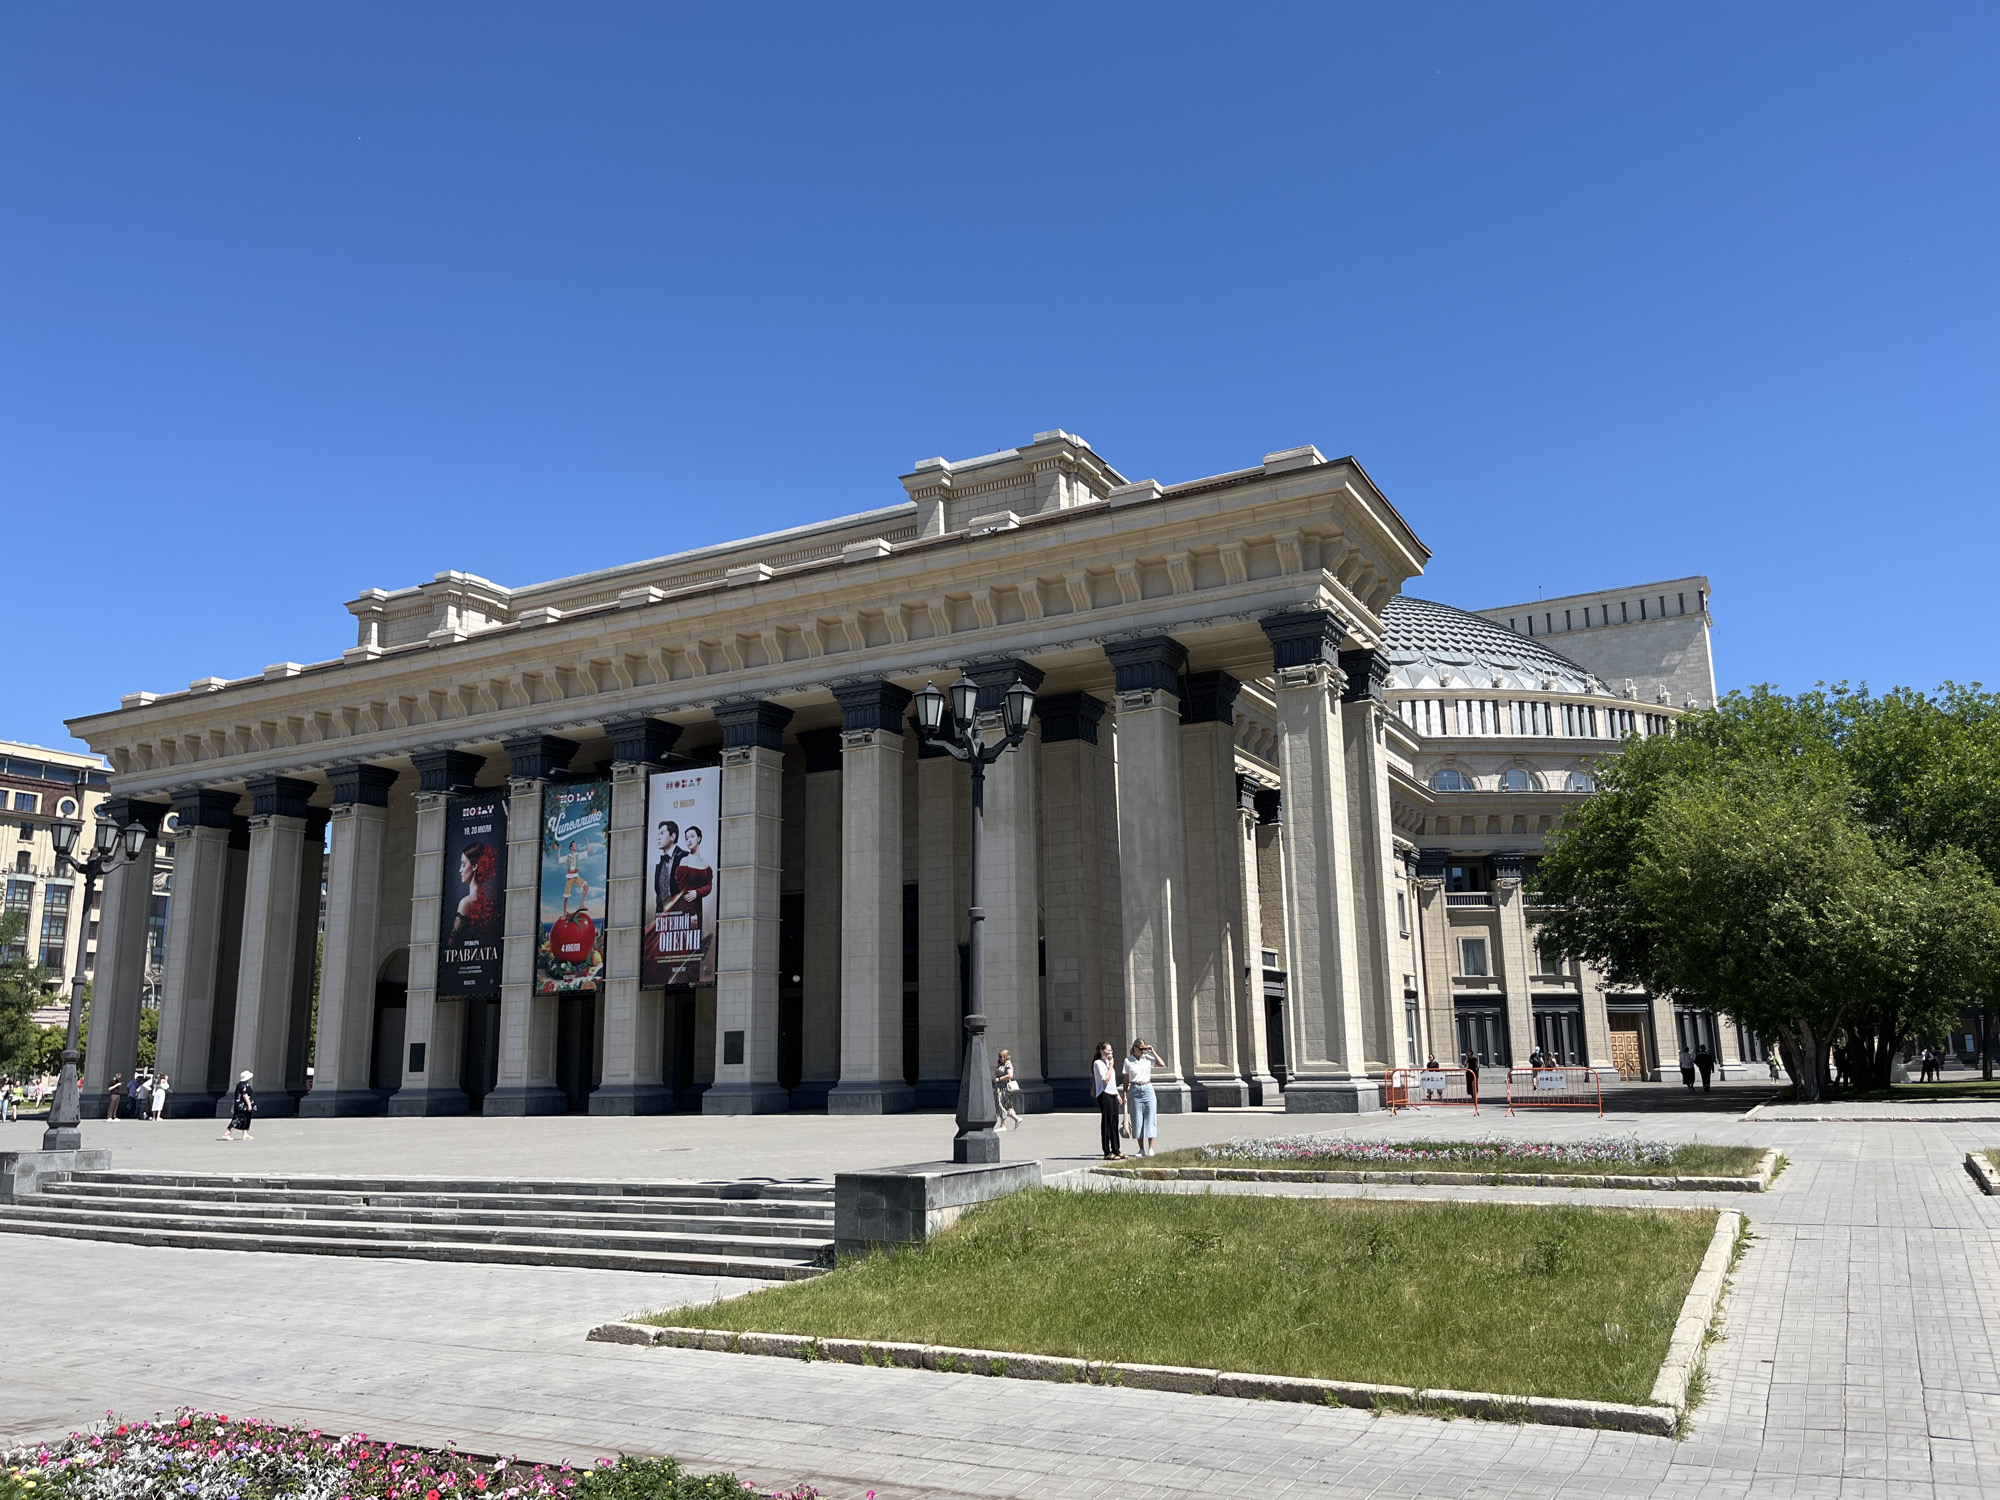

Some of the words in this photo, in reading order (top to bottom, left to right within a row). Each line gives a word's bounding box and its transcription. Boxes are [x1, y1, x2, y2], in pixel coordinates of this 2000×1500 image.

[547, 810, 602, 841] Чиполлино
[655, 912, 690, 932] ЕВГЕНИЙ
[560, 943, 565, 953] 4
[659, 929, 701, 952] ОНЕГИН
[445, 946, 498, 963] ТРАВИАТА
